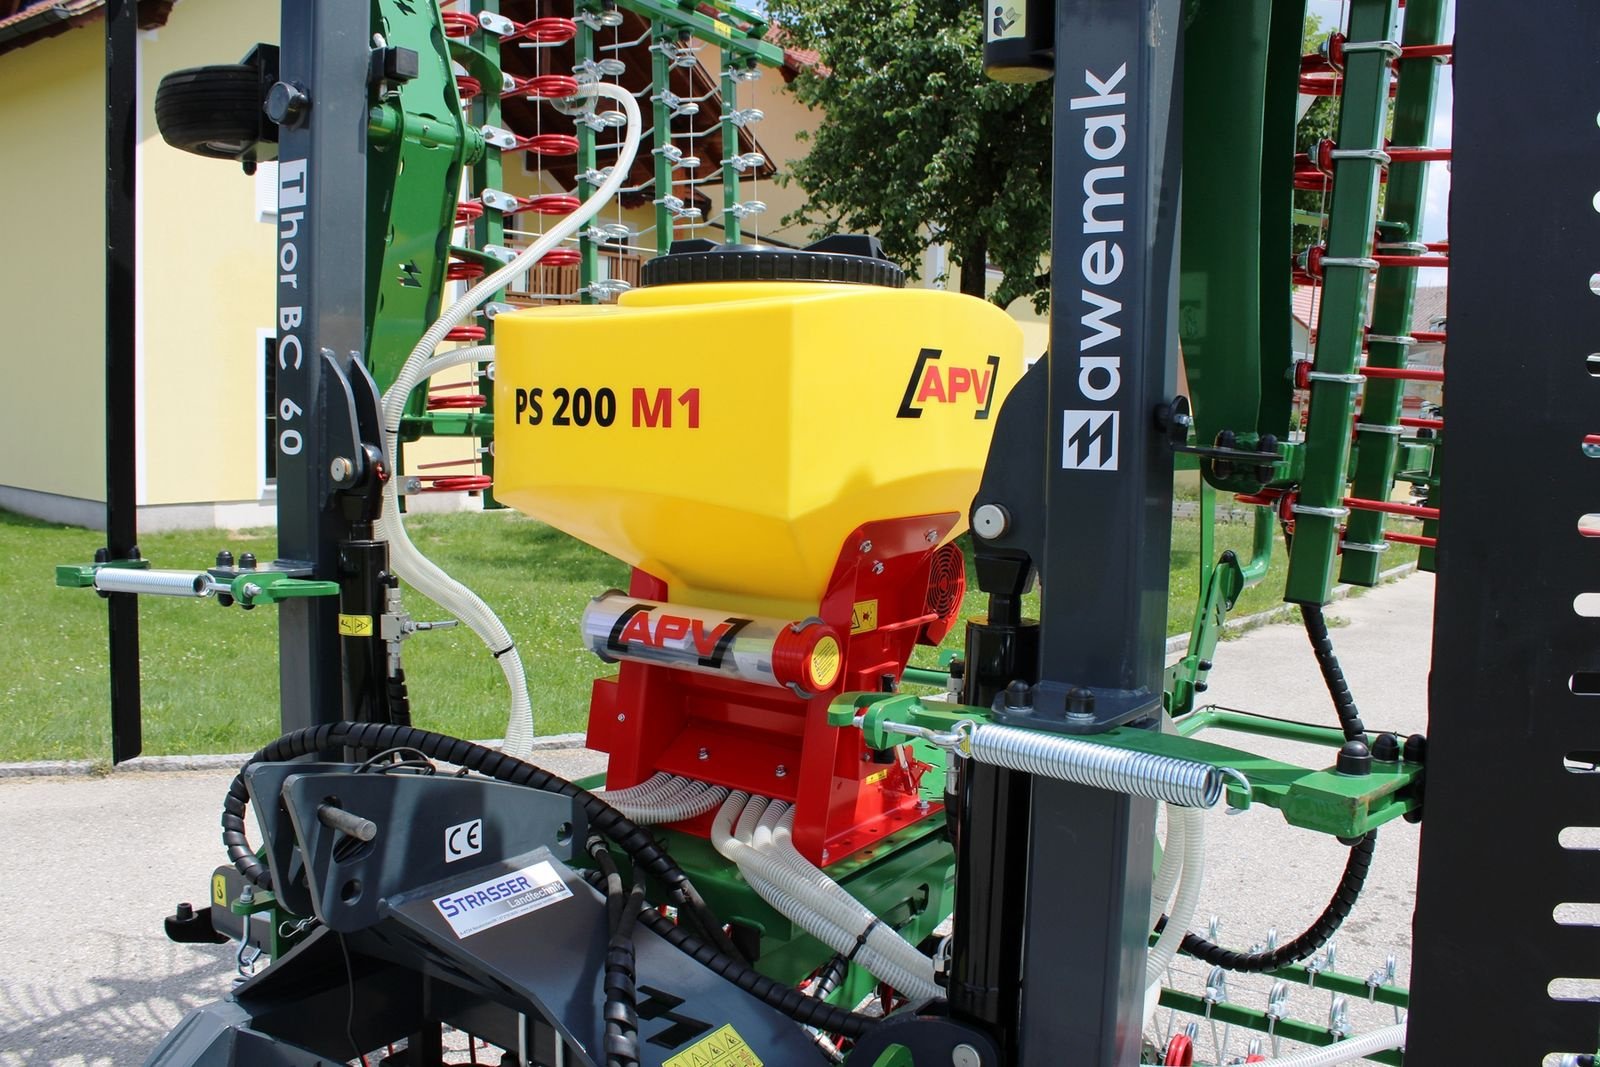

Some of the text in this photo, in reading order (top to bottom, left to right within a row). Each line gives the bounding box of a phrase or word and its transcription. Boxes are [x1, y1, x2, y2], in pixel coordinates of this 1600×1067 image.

[1070, 61, 1126, 401] awemak
[279, 168, 306, 456] Thor BC 60
[515, 387, 700, 429] PS 200 M1
[448, 822, 479, 855] CE
[438, 876, 532, 918] STRASSER
[506, 880, 565, 909] Landtechnik
